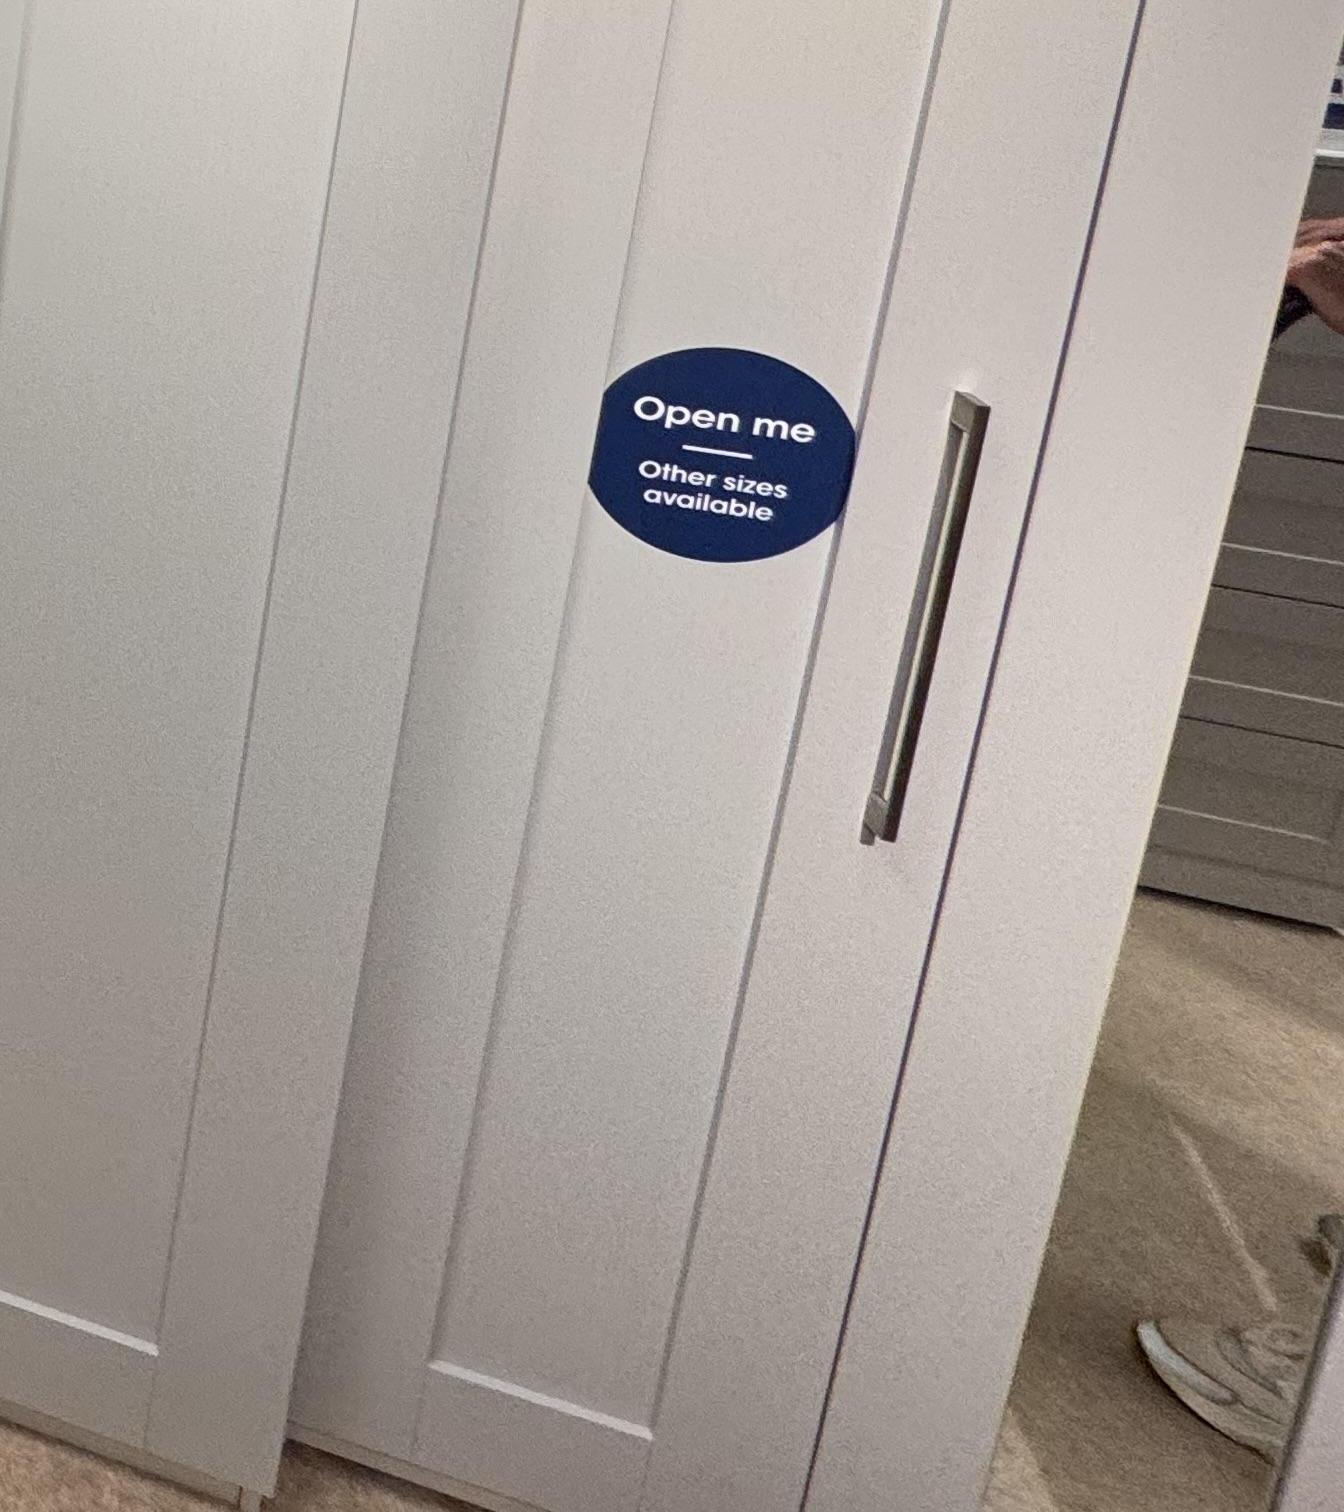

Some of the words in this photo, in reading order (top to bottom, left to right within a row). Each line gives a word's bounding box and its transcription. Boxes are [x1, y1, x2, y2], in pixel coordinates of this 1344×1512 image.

[633, 395, 740, 433] Open
[752, 417, 817, 443] me
[638, 460, 717, 487] Other
[722, 475, 789, 499] sizes
[643, 488, 774, 522] available
